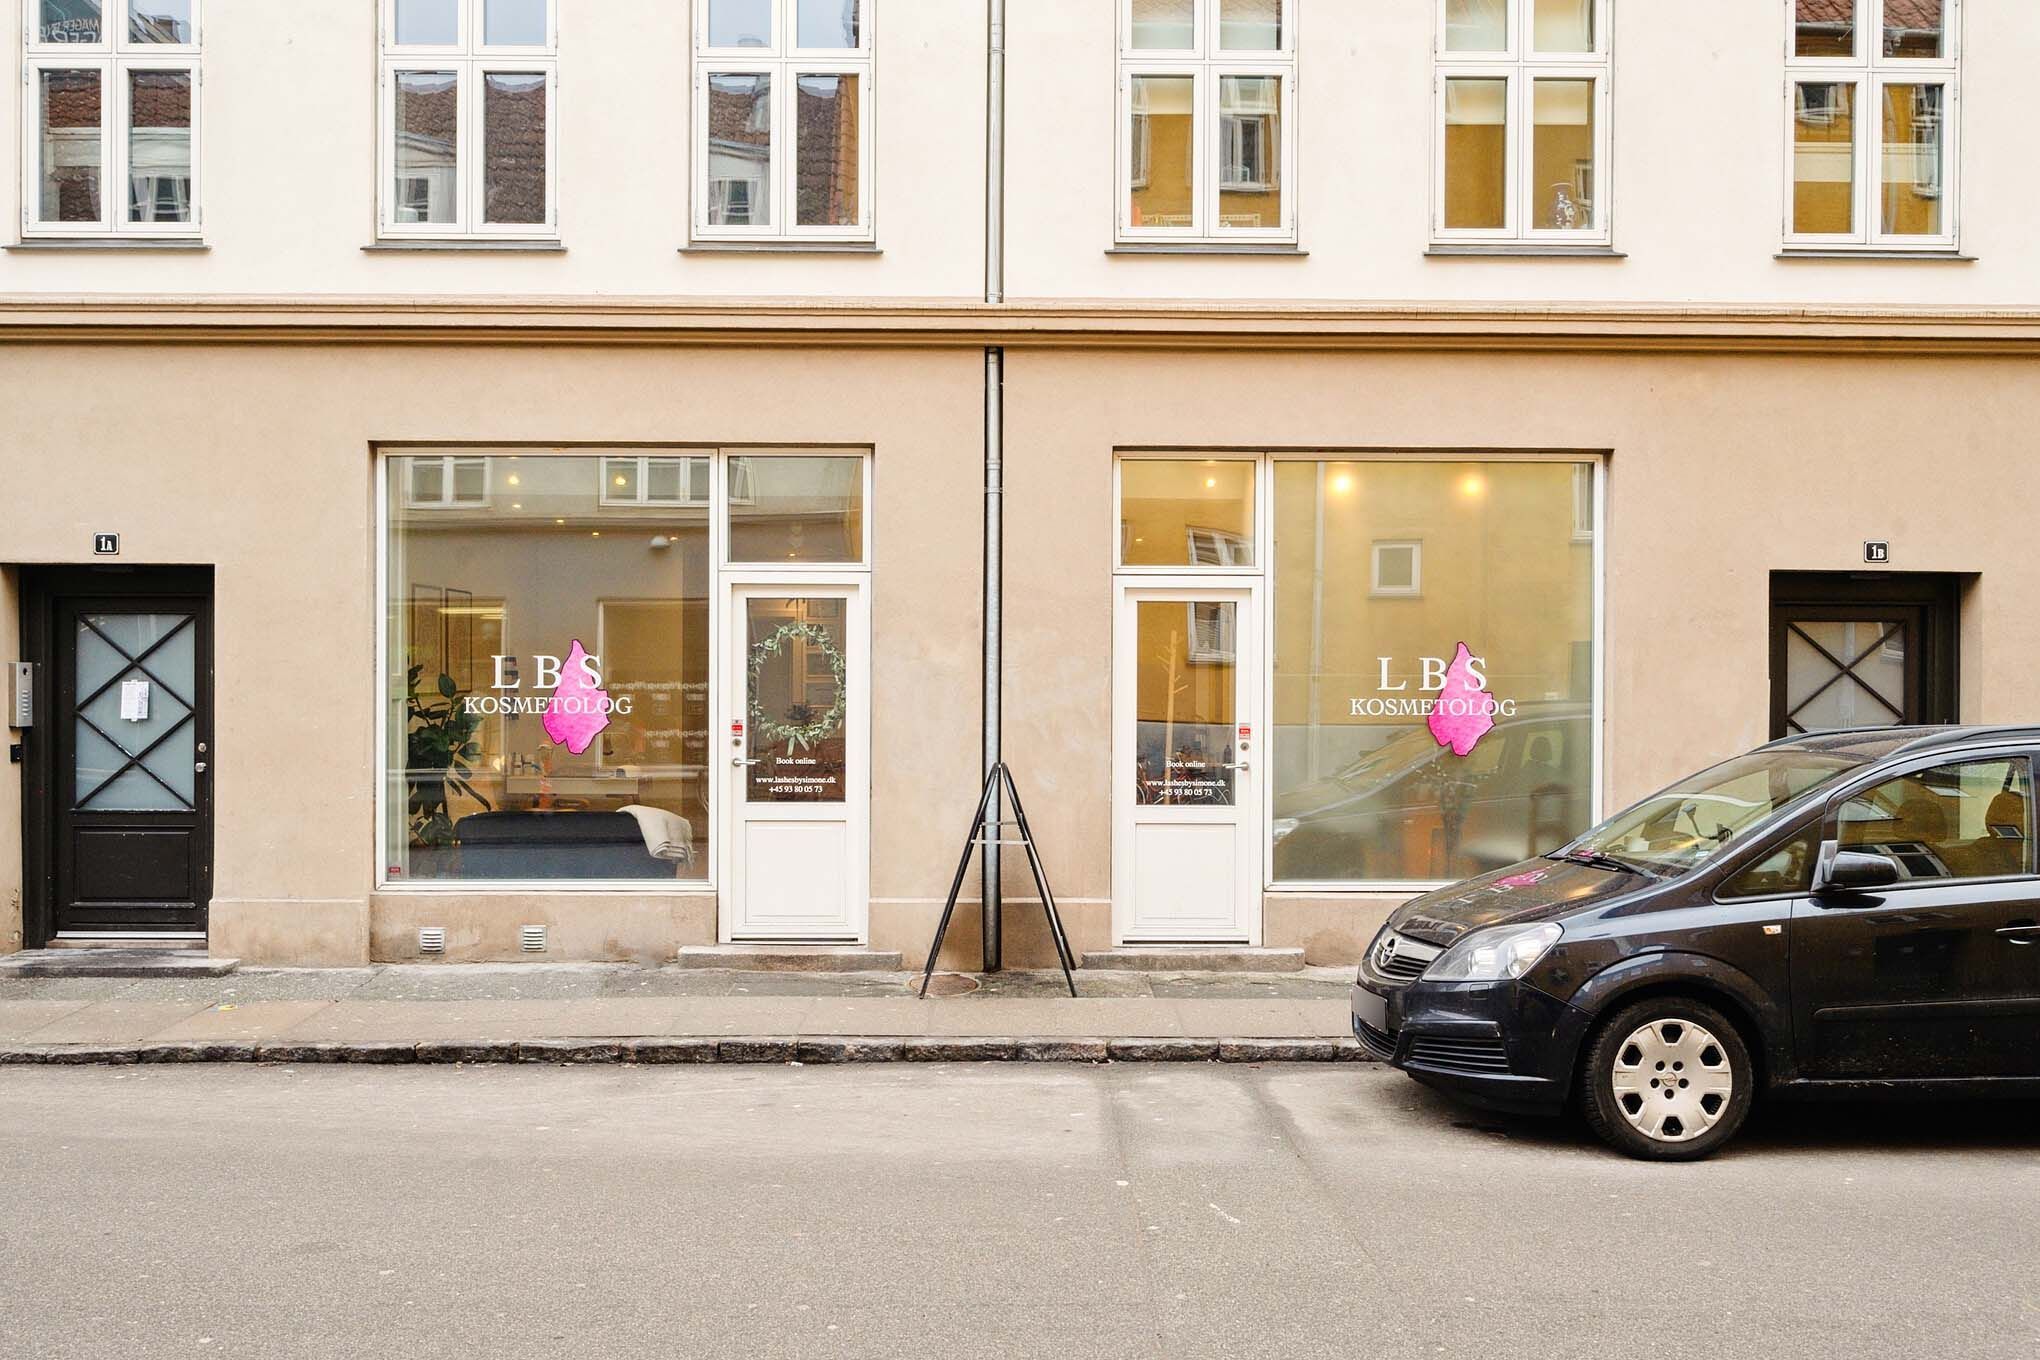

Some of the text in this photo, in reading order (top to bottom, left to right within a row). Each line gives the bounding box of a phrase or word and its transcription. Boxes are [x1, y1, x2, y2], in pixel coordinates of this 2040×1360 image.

[1871, 545, 1885, 559] 1B
[463, 696, 633, 715] KOSMETOLOG
[1350, 698, 1517, 717] KOSMETOLOG
[776, 757, 817, 765] Book online
[1166, 760, 1206, 768] Book online
[769, 785, 823, 793] +45 93 80 05 73
[1174, 788, 1183, 796] 93
[1184, 788, 1193, 796] 80
[1194, 788, 1203, 796] 05
[1204, 788, 1213, 796] 73
